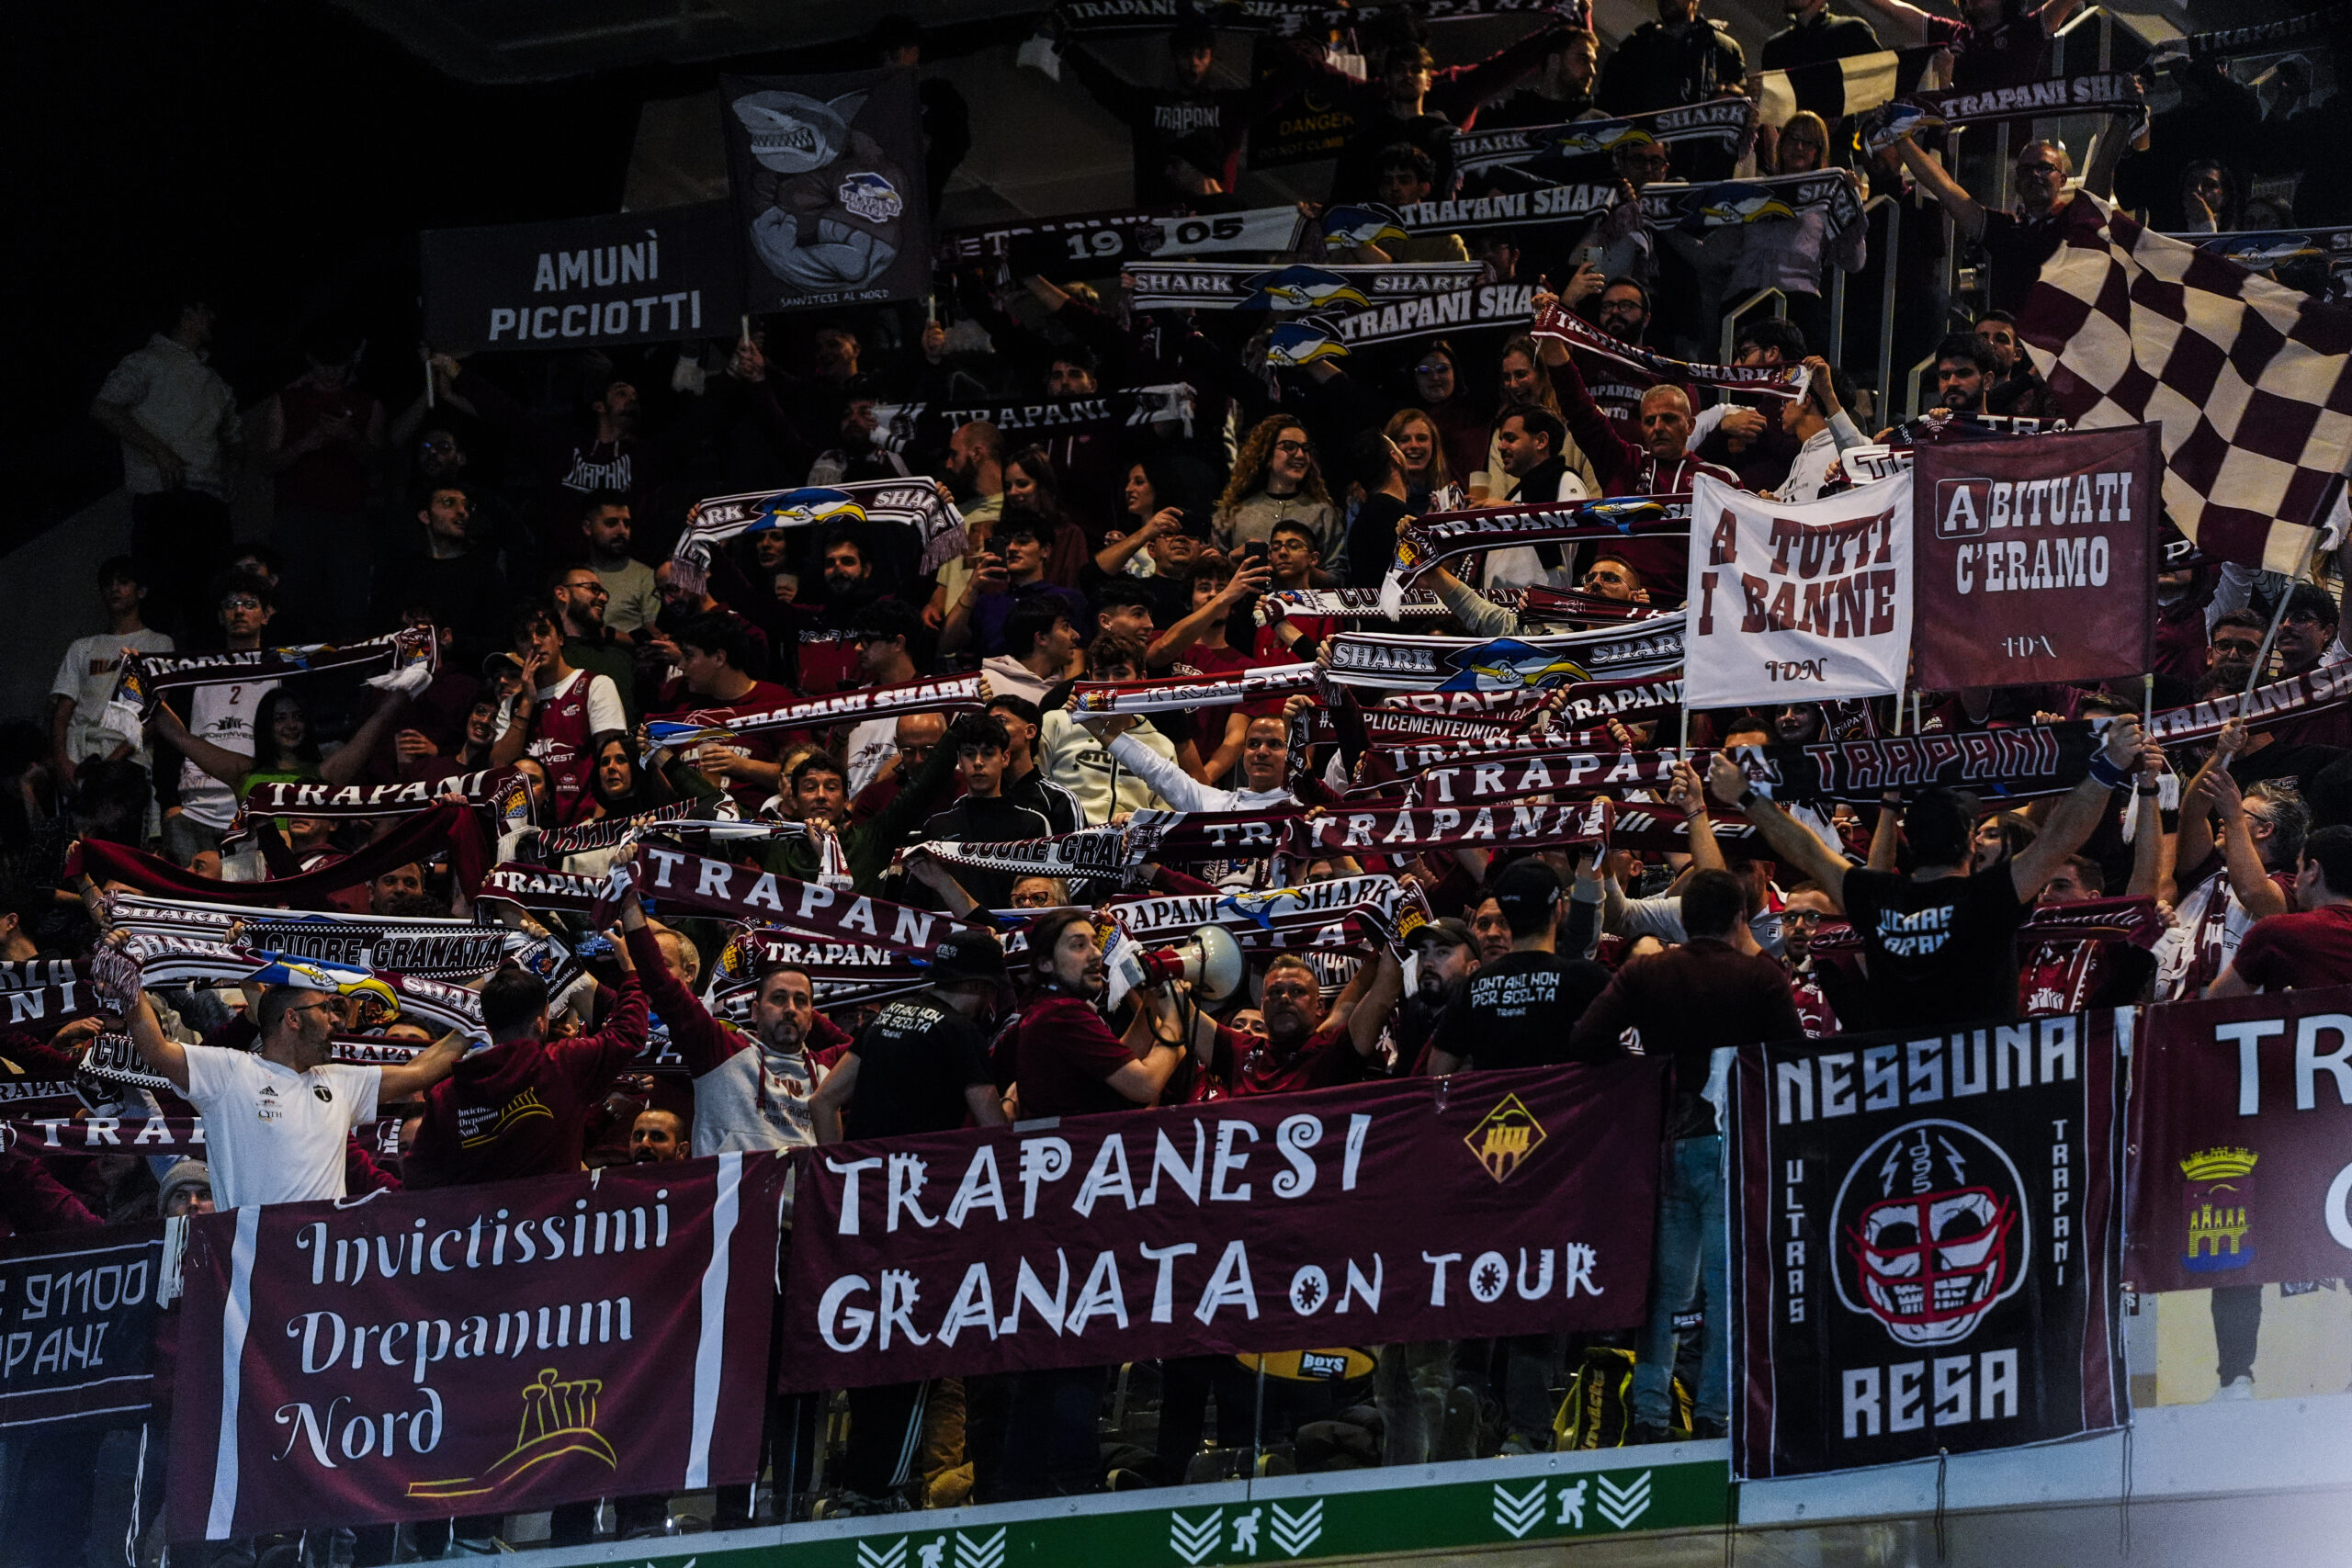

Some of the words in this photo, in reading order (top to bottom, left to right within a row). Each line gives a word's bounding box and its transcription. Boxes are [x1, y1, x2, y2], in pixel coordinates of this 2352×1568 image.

[1154, 106, 1220, 130] TRAPANI
[1655, 104, 1746, 132] SHARK
[1939, 77, 2067, 119] TRAPANI
[1397, 189, 1527, 225] TRAPANI
[1066, 230, 1124, 260] 19
[1176, 217, 1244, 244] 05
[534, 229, 659, 292] AMUNÌ
[842, 293, 856, 301] AL
[1135, 273, 1233, 294] SHARK
[1373, 275, 1472, 293] SHARK
[489, 289, 702, 341] PICCIOTTI
[1339, 286, 1473, 341] TRAPANI
[1478, 281, 1544, 321] SHA
[1555, 310, 1648, 364] TRAPANI
[1688, 363, 1771, 382] SHARK
[942, 398, 1111, 434] TRAPANI
[1429, 508, 1577, 539] TRAPANI
[1710, 508, 1737, 566] A
[1770, 504, 1896, 580] TUTTI
[1956, 535, 2109, 595] C'ERAMO
[1334, 588, 1439, 609] CURE
[1699, 571, 1719, 636] I
[1741, 570, 1896, 638] BANNE
[1333, 643, 1436, 672] SHARK
[229, 685, 241, 705] 2
[726, 692, 867, 731] TRAPANI
[874, 677, 980, 706] SHARK
[1147, 669, 1316, 703] TRAPAN
[2152, 677, 2305, 739] TRAPANI
[1388, 730, 1590, 772] TRAPANI
[1803, 727, 2060, 792] TRAPANI
[266, 769, 483, 807] TRAPANI
[1305, 806, 1575, 849] TRAPANI
[492, 869, 606, 901] TRAPAN
[1294, 879, 1395, 910] SHARK
[112, 905, 232, 926] SHARK
[1109, 897, 1220, 930] RAPANI
[124, 932, 243, 964] SHARK
[370, 932, 511, 969] GRANATA
[765, 942, 893, 966] TRAPANI
[401, 976, 484, 1021] SHAR
[1470, 973, 1528, 994] LONTANI
[1531, 972, 1561, 987] NON
[1471, 989, 1498, 1009] PER
[1501, 987, 1556, 1005] SCELTA
[891, 1015, 933, 1034] SCELTA
[1776, 1014, 2077, 1125] NESSUNA
[825, 1111, 1373, 1236] TRAPANESI
[1910, 1128, 1934, 1194] 1995
[2052, 1118, 2070, 1287] TRAPANI
[296, 1188, 670, 1287] Invictissimi
[1785, 1158, 1806, 1325] ULTRAS
[22, 1259, 148, 1320] 91100
[817, 1239, 1260, 1353] GRANATA
[1289, 1251, 1383, 1317] ON
[1421, 1241, 1604, 1308] TOUR
[0, 1321, 109, 1379] PANI
[286, 1295, 634, 1384] Drepanum
[1302, 1352, 1346, 1373] BOYS
[1842, 1348, 2019, 1439] RESA
[272, 1387, 444, 1468] Nord
